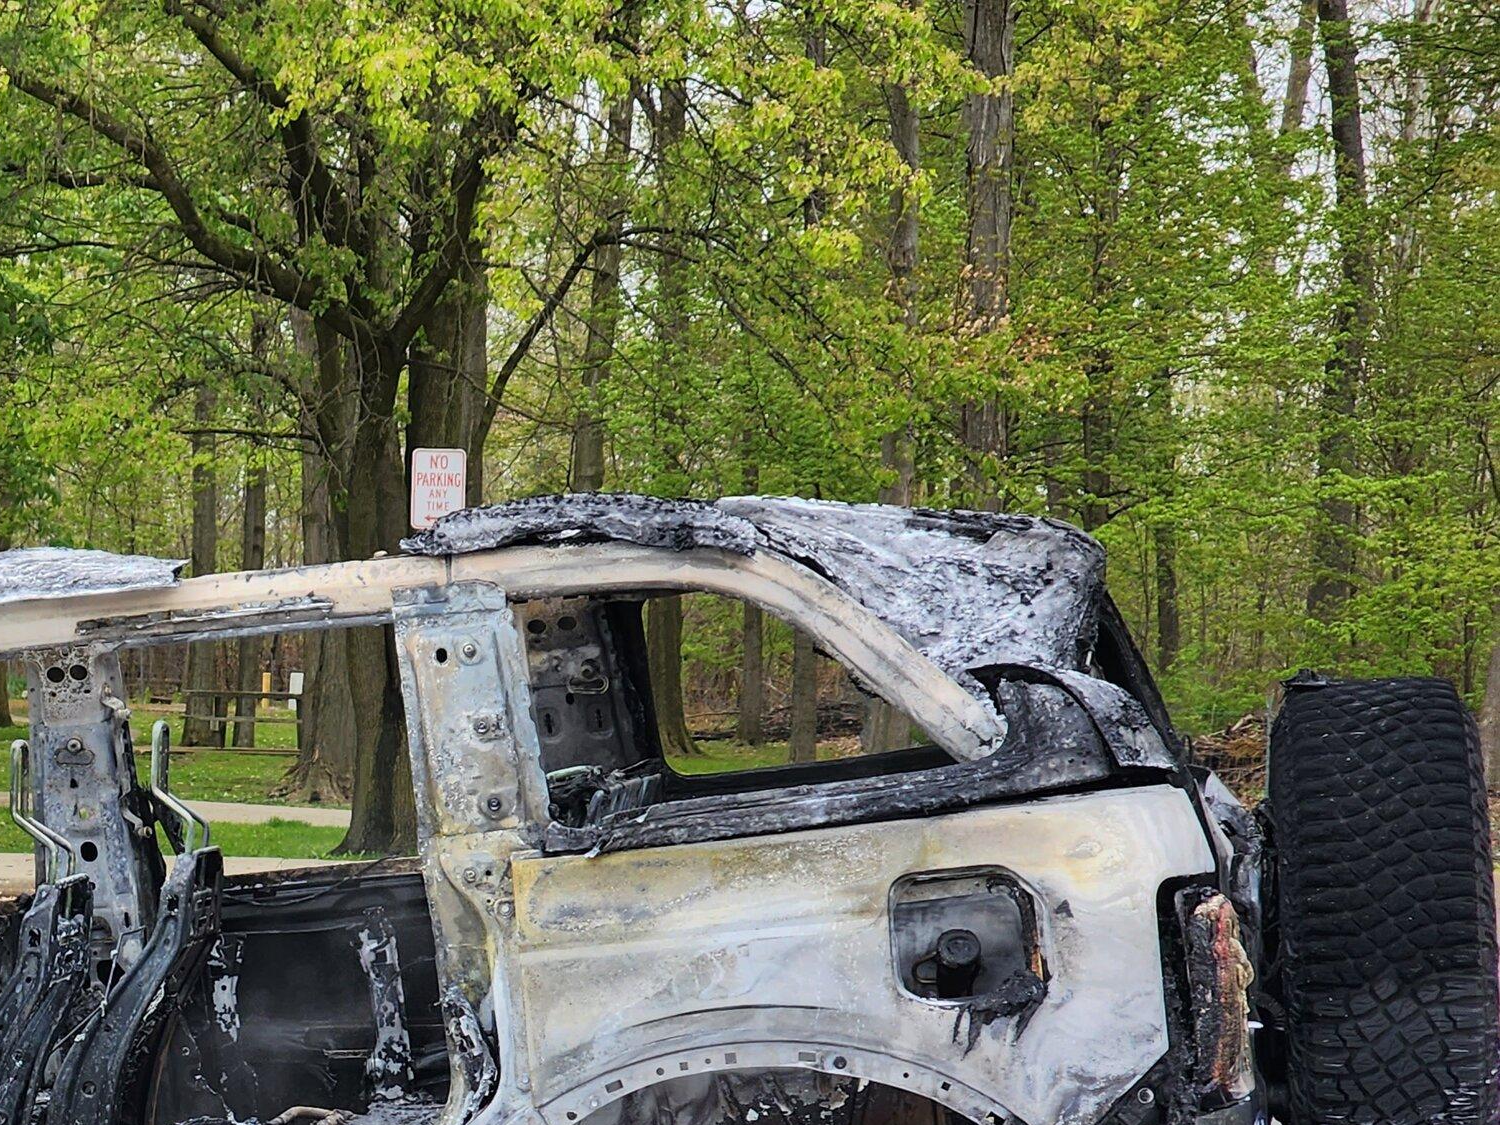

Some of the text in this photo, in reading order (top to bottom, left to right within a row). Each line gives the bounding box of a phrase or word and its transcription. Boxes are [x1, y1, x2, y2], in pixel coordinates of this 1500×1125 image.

[430, 454, 449, 470] NO
[416, 472, 461, 488] PARKING
[429, 489, 448, 499] ANY
[426, 501, 450, 512] TIME
